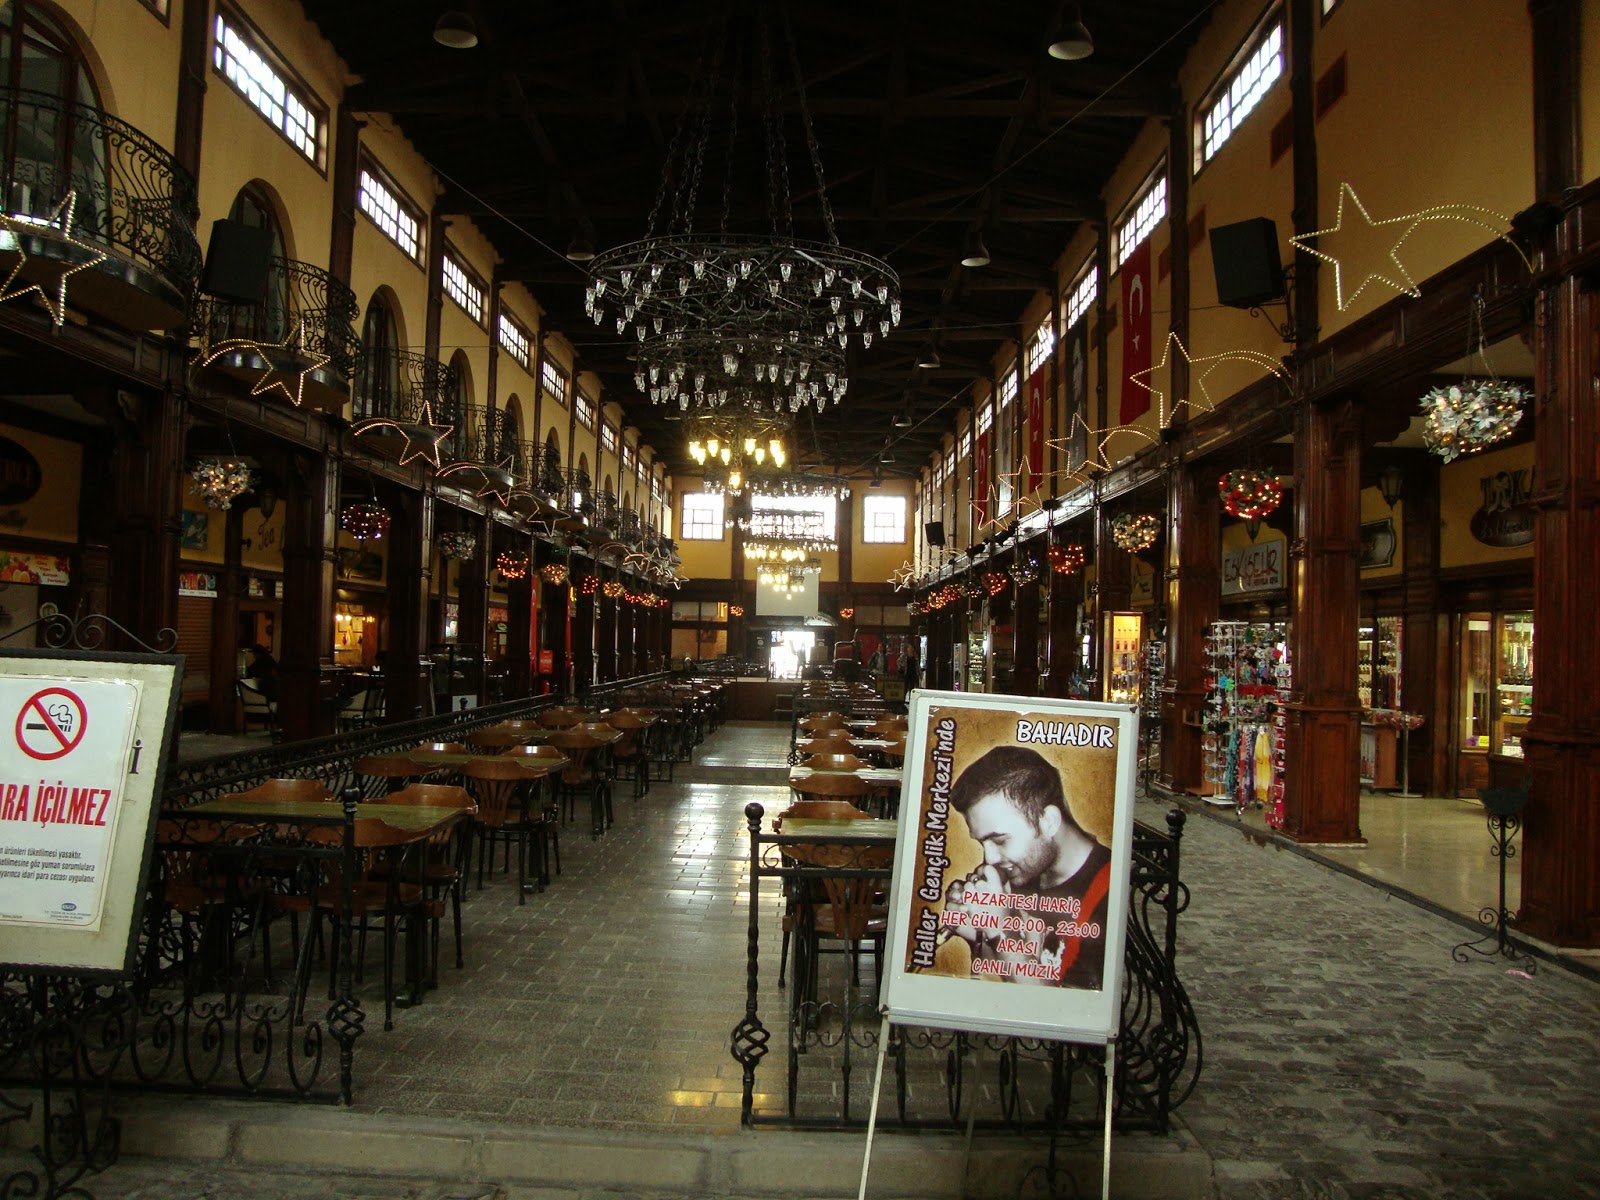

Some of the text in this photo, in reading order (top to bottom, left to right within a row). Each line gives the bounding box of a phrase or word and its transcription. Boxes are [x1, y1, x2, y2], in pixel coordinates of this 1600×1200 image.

[1016, 719, 1114, 749] BAHADIR
[33, 779, 112, 829] İÇİLMEZ
[4, 846, 27, 856] ürünleri
[27, 848, 57, 858] tüketilmesi
[913, 717, 957, 969] Haller Gençlik Merkezi'nde
[21, 870, 35, 880] idari
[36, 872, 49, 881] para
[50, 873, 68, 882] cezası
[30, 859, 40, 870] göz
[41, 861, 61, 870] yuman
[61, 862, 96, 872] sorumlulara
[962, 890, 1081, 918] PAZARTESİ HARİÇ
[940, 910, 967, 927] HER
[970, 911, 999, 930] GÜN
[1002, 915, 1045, 934] 20:00
[1056, 920, 1101, 939] 23:00
[996, 937, 1038, 955] ARASI
[971, 959, 1061, 980] CANLI MÜZİK
